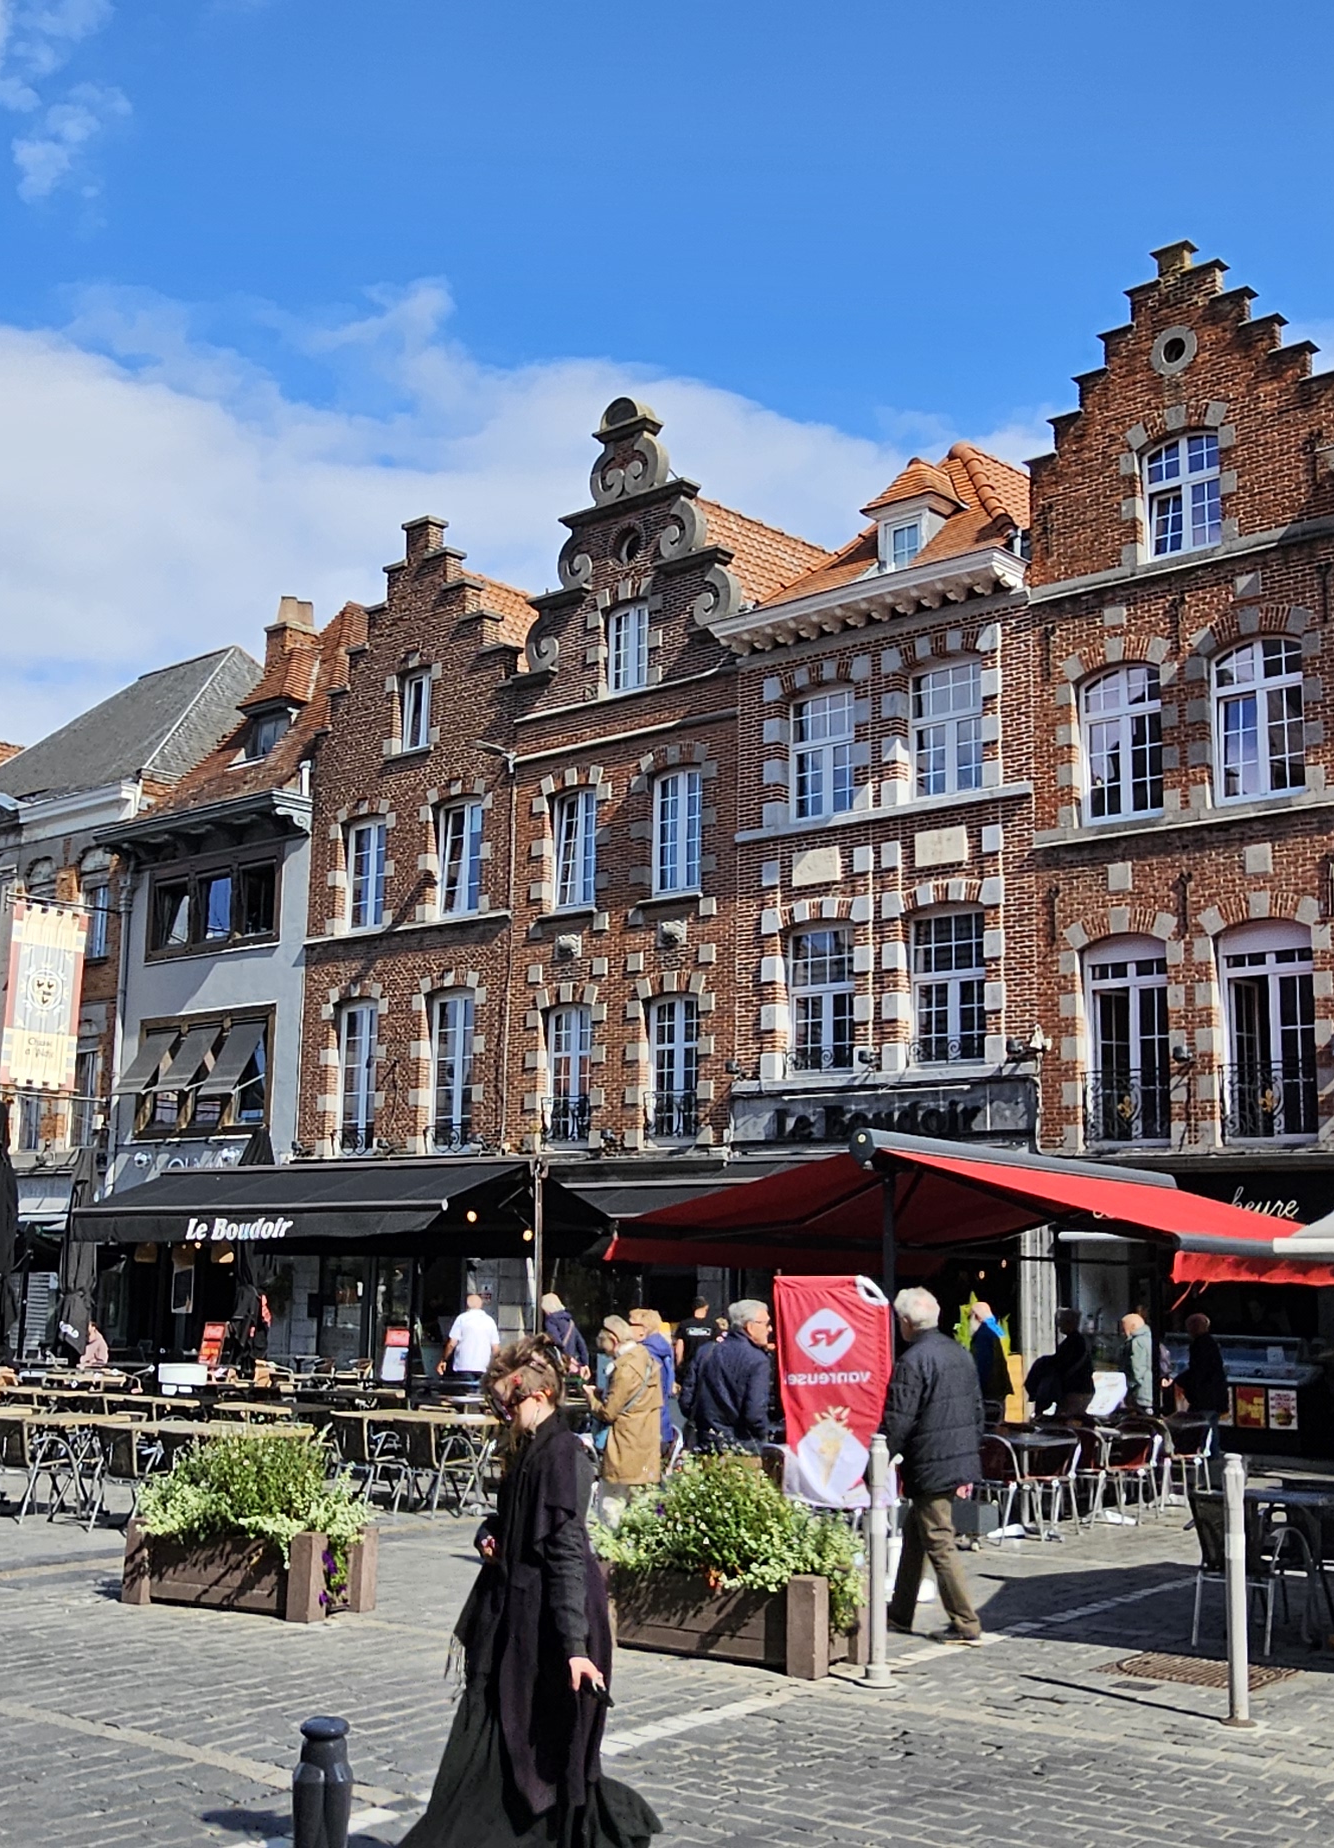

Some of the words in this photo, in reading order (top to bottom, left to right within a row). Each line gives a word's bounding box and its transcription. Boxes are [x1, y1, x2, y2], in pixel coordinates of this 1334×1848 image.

[824, 1101, 980, 1136] Boudoir
[185, 1217, 209, 1240] Le
[211, 1217, 294, 1241] Boudoir
